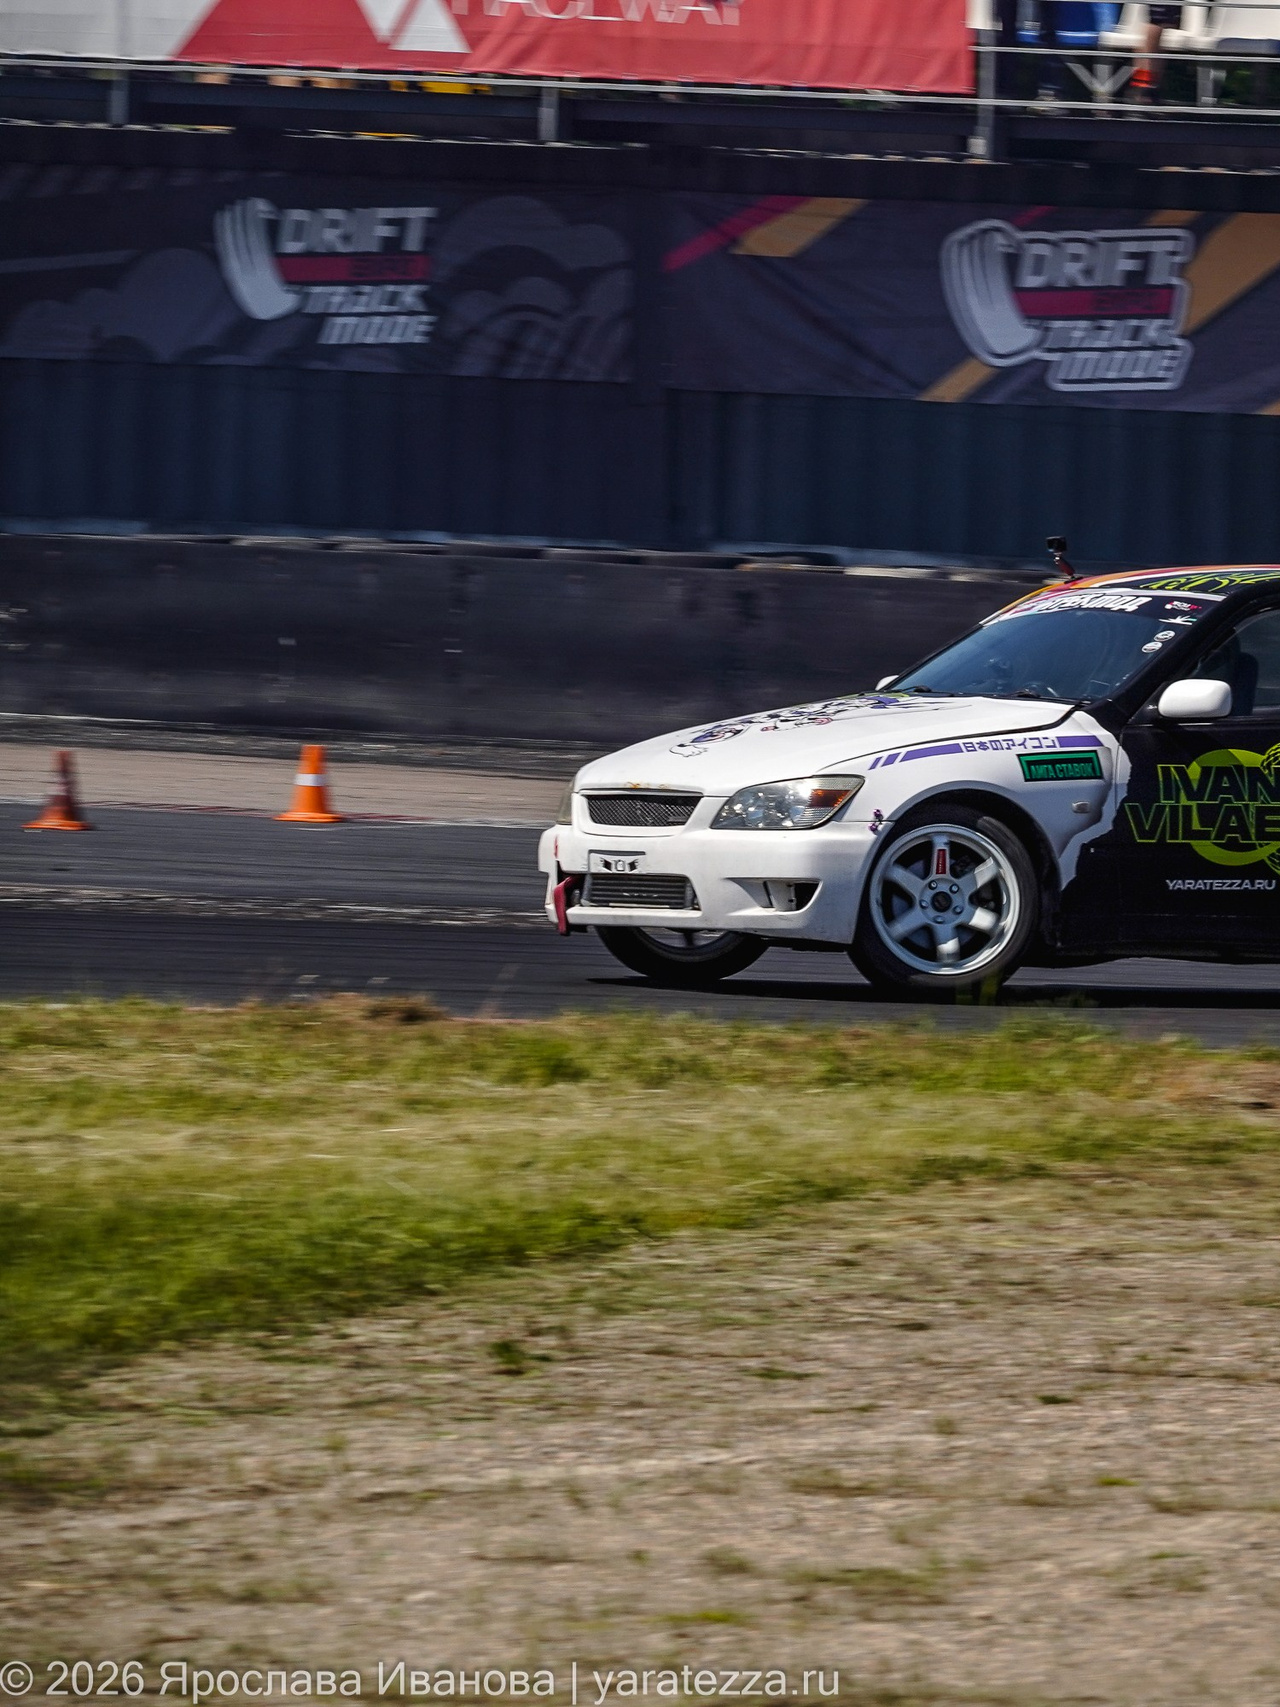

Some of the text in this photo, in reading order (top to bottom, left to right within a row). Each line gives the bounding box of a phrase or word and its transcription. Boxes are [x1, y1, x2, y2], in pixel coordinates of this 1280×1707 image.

[277, 207, 438, 253] DRIFT
[1014, 239, 1183, 288] DRIFT
[962, 735, 1058, 753] 日本のアイコン
[1029, 763, 1094, 779] ЛИГА СТАВОК
[1166, 879, 1277, 891] YARATEZZA.RU
